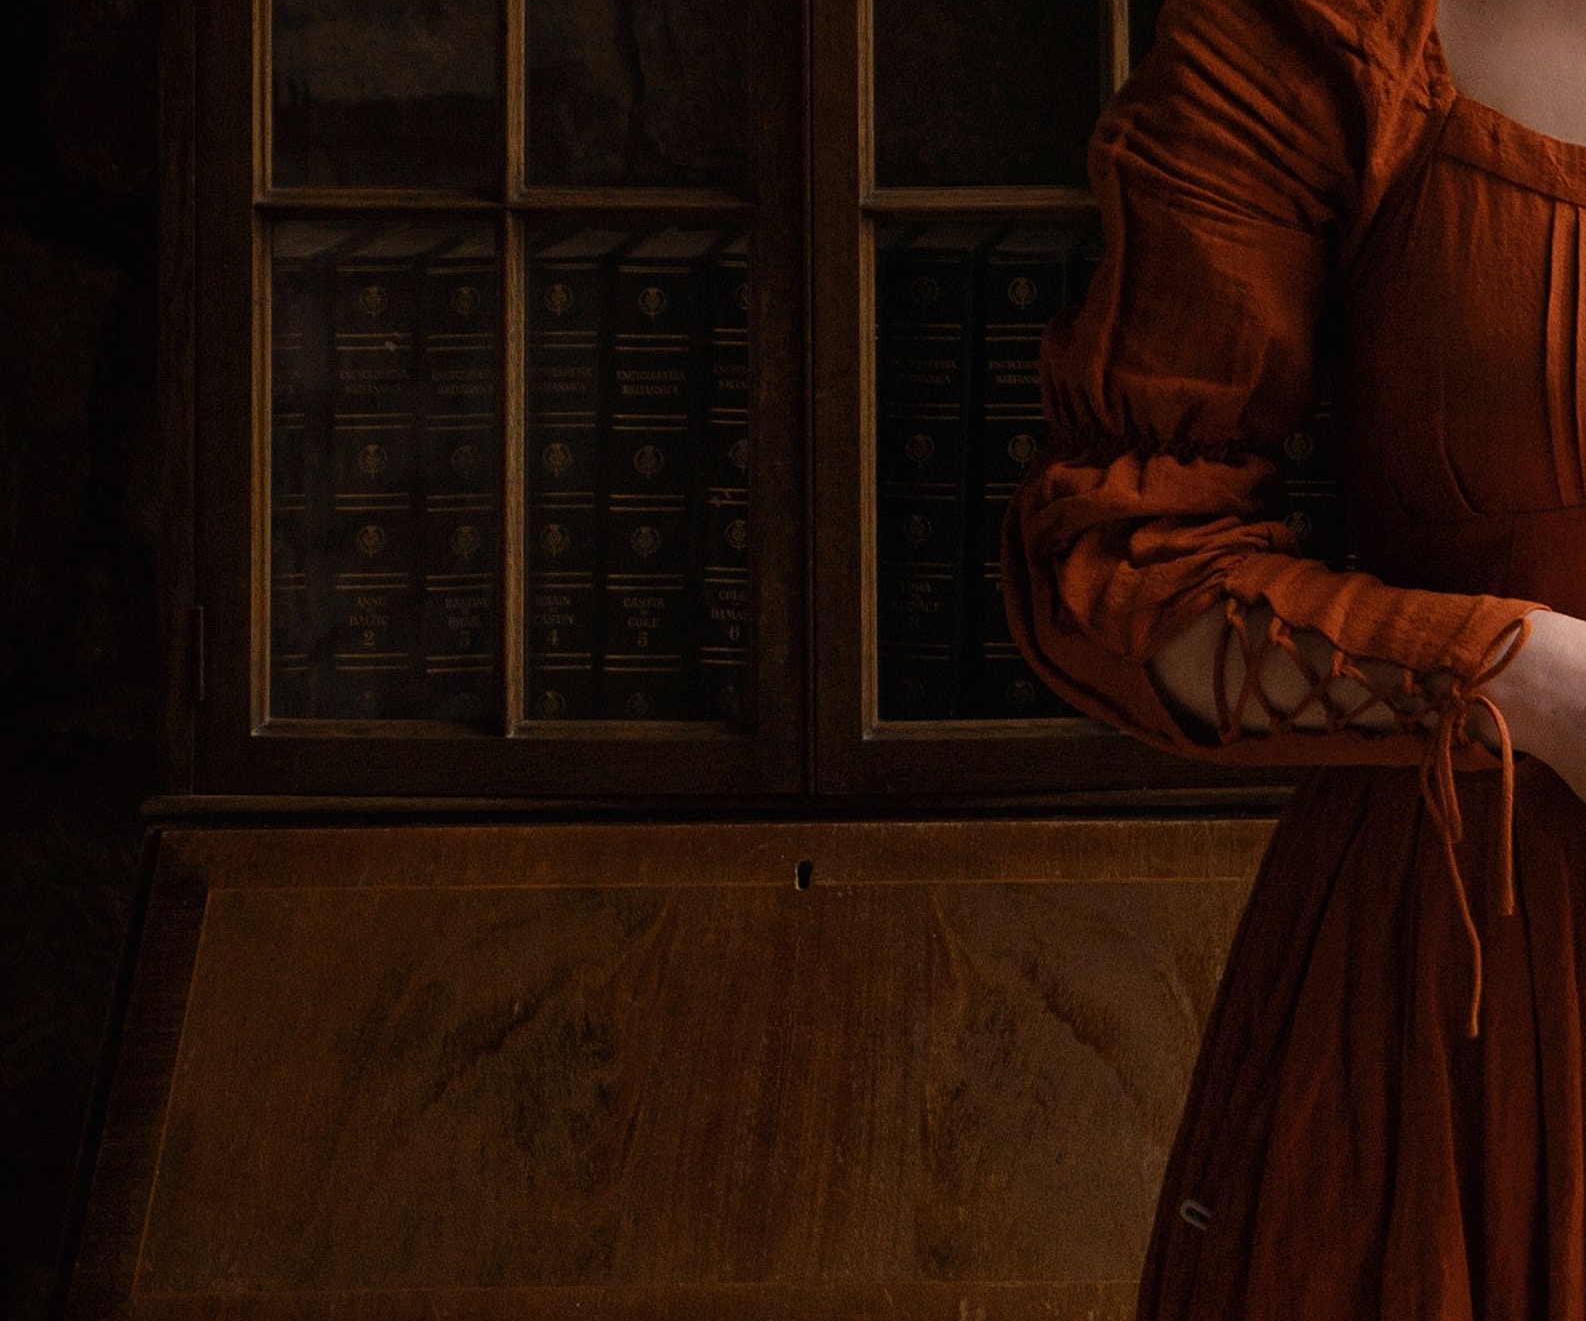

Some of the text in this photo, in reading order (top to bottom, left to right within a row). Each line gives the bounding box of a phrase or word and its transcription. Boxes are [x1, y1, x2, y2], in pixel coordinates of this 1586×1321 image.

[363, 630, 375, 647] 2
[547, 629, 560, 646] 4
[637, 631, 649, 648] 5
[728, 625, 741, 642] 6
